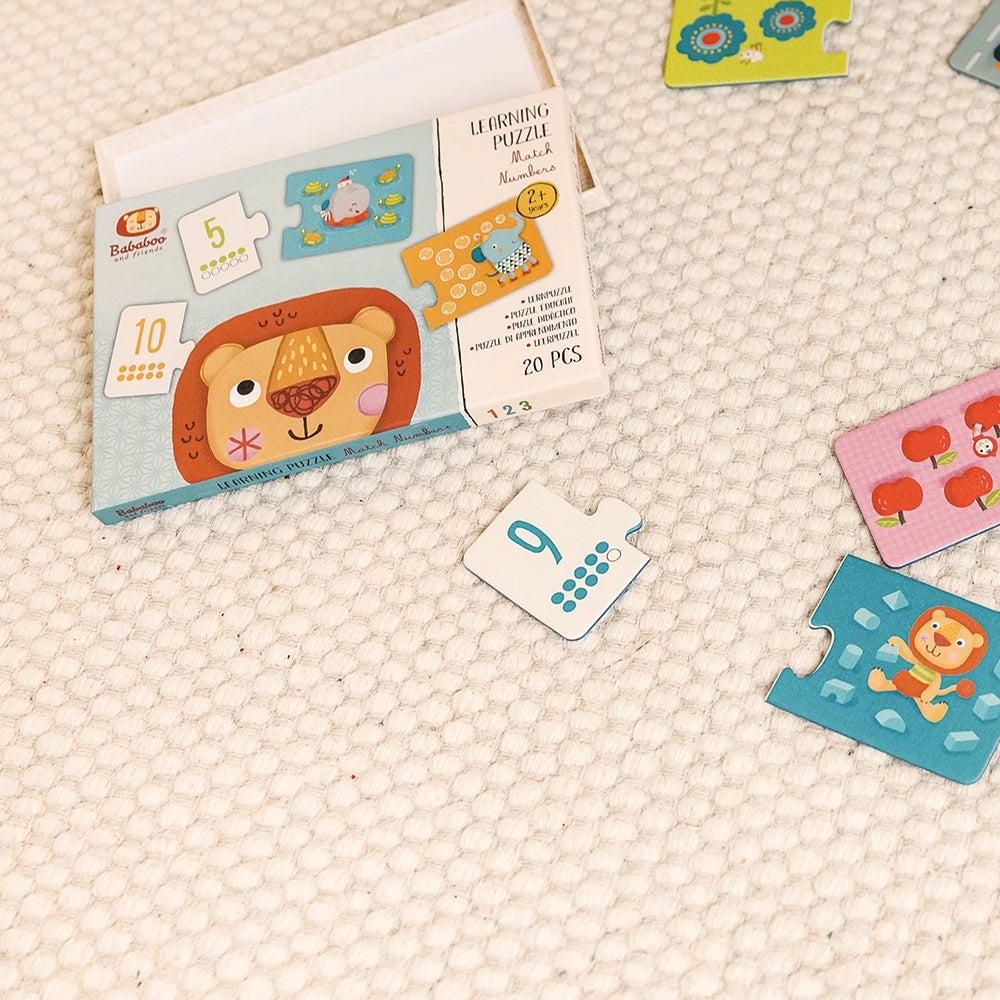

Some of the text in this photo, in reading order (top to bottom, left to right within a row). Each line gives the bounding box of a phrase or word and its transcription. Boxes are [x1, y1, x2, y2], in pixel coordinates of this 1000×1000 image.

[470, 102, 549, 136] LEARNING
[493, 121, 553, 151] PUZZLE
[510, 141, 554, 165] Match
[498, 163, 557, 186] Numbers
[527, 188, 547, 204] 2+
[528, 202, 549, 214] years
[203, 216, 225, 249] 5
[109, 235, 168, 258] Bababoo
[113, 245, 164, 263] and friends
[510, 306, 536, 320] PUZZLE
[133, 316, 167, 356] 10
[475, 337, 501, 352] PUZZLE
[522, 356, 544, 376] 20
[550, 344, 583, 369] PCS
[487, 400, 533, 419] 1 2 3
[216, 424, 452, 491] LEARNING PUZZLE Match Numbers
[115, 500, 166, 518] Bababoo
[506, 519, 563, 566] 9
